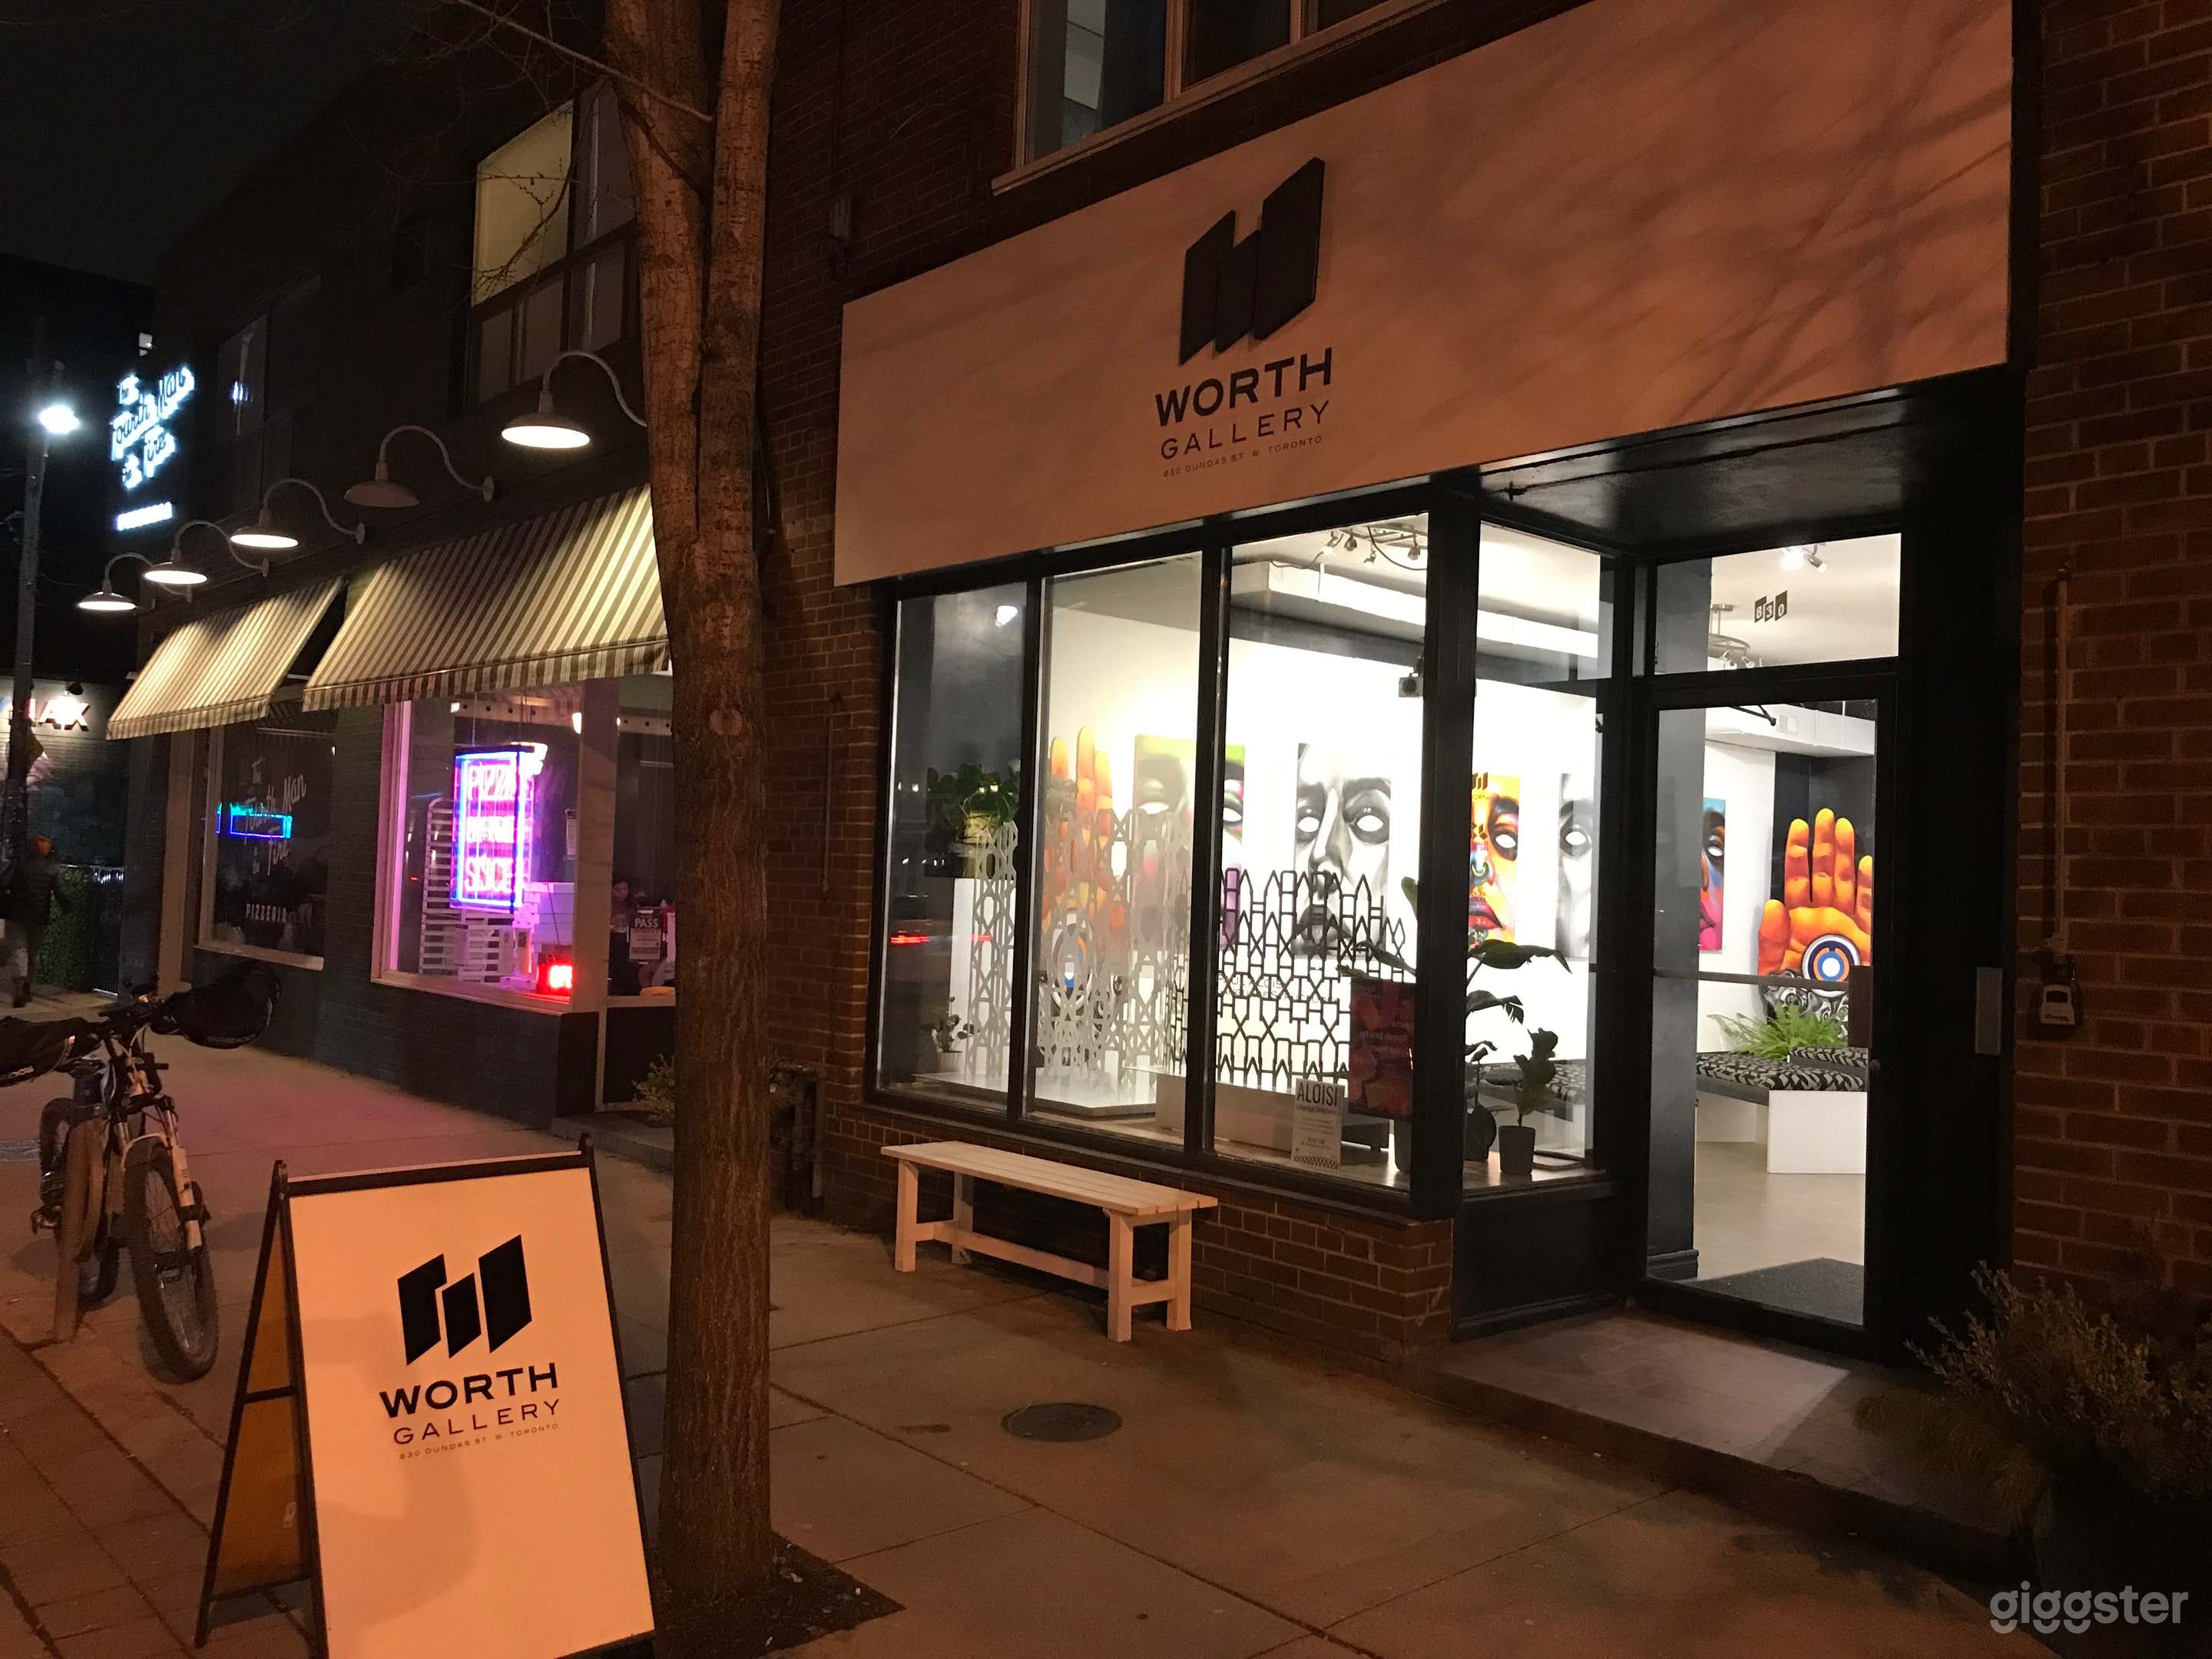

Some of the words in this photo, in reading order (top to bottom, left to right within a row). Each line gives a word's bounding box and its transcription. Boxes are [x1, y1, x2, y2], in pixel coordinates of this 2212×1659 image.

[1155, 346, 1333, 427] WORTH
[1161, 399, 1330, 460] GALLERY
[1185, 456, 1227, 472] DUNDAS
[1230, 452, 1244, 462] ST
[1268, 435, 1323, 454] TORONTO
[245, 902, 287, 922] PIZZERIA
[634, 917, 659, 929] PASS
[1296, 1082, 1339, 1107] ALOISI
[379, 1362, 558, 1419] WORTH
[393, 1398, 559, 1445] GALLERY
[425, 1439, 471, 1455] DUNDAS
[475, 1436, 487, 1445] ST
[510, 1422, 559, 1438] TORONTO
